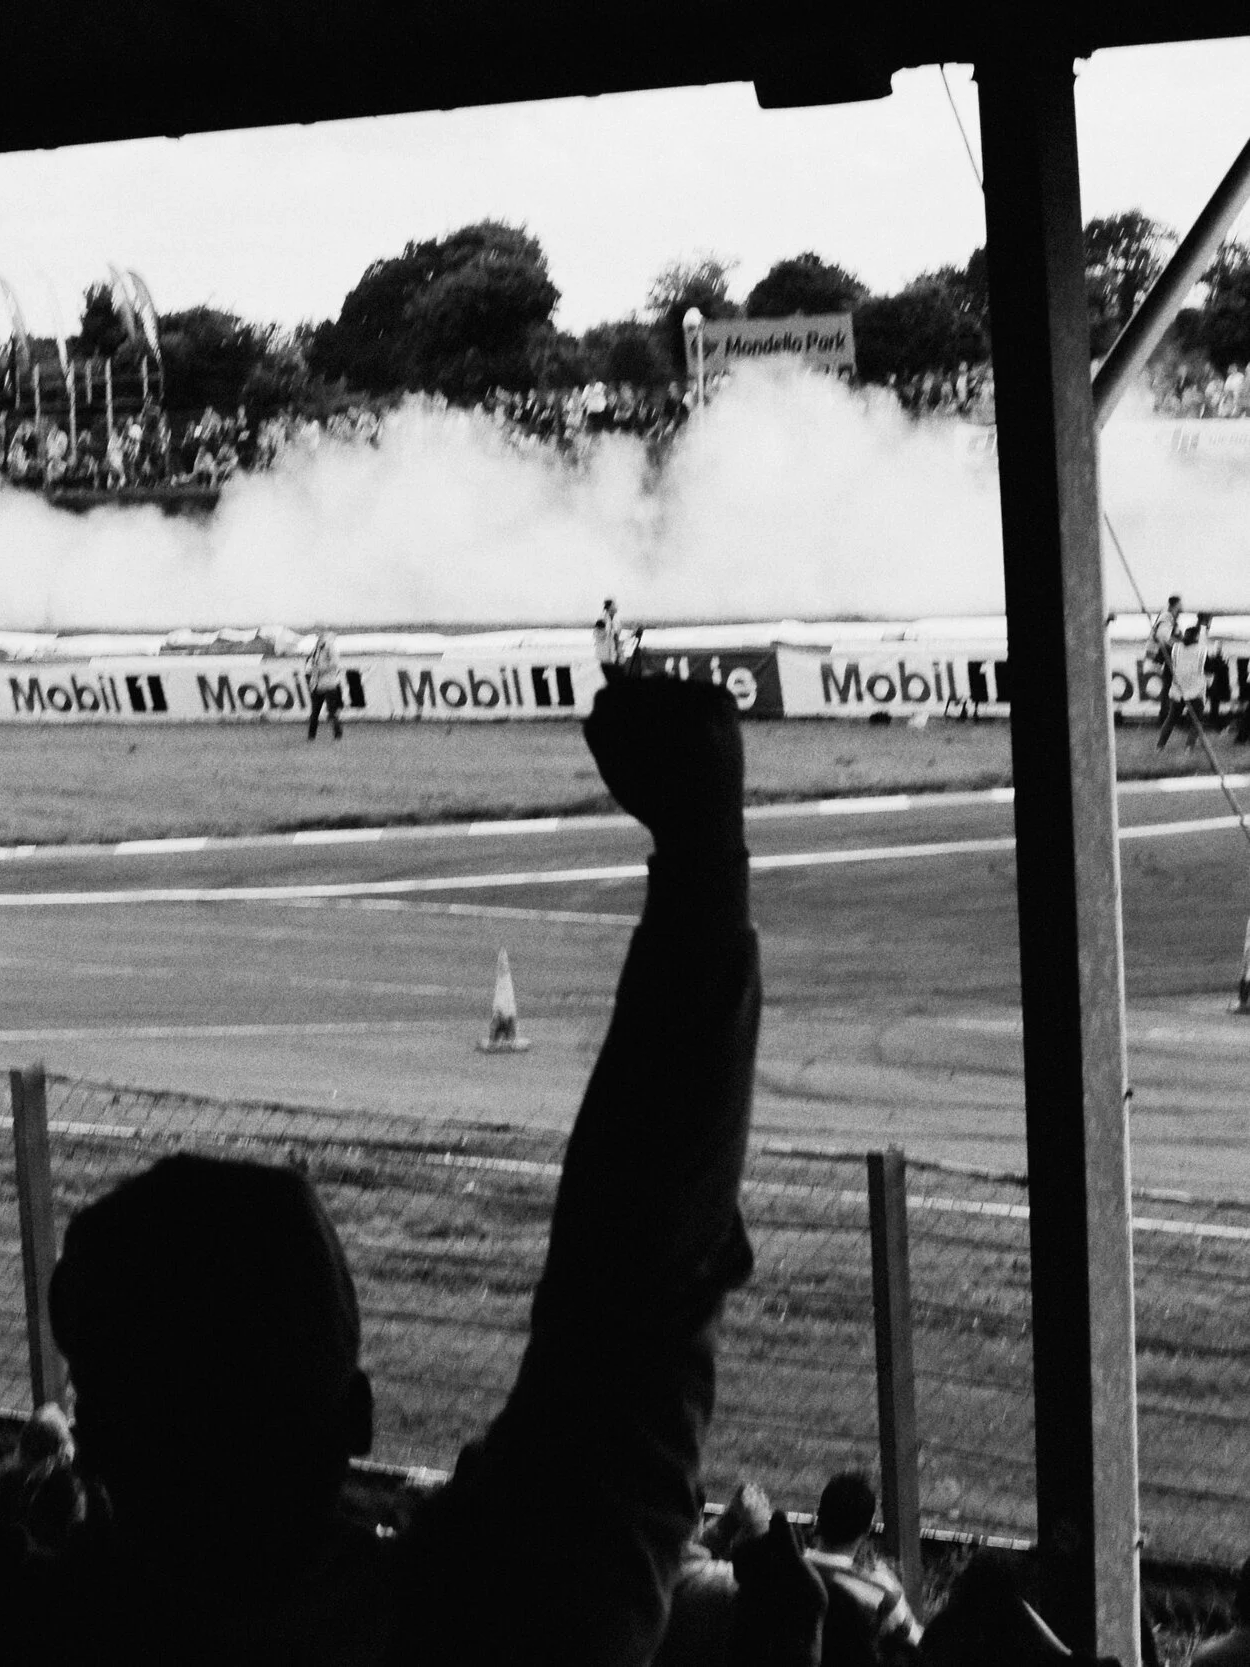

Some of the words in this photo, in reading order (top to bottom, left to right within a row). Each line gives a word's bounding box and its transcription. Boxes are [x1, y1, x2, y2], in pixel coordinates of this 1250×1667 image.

[9, 674, 121, 713] Mobil
[397, 667, 524, 708] Mobil
[531, 666, 575, 706] 1
[820, 661, 958, 704] Mobil
